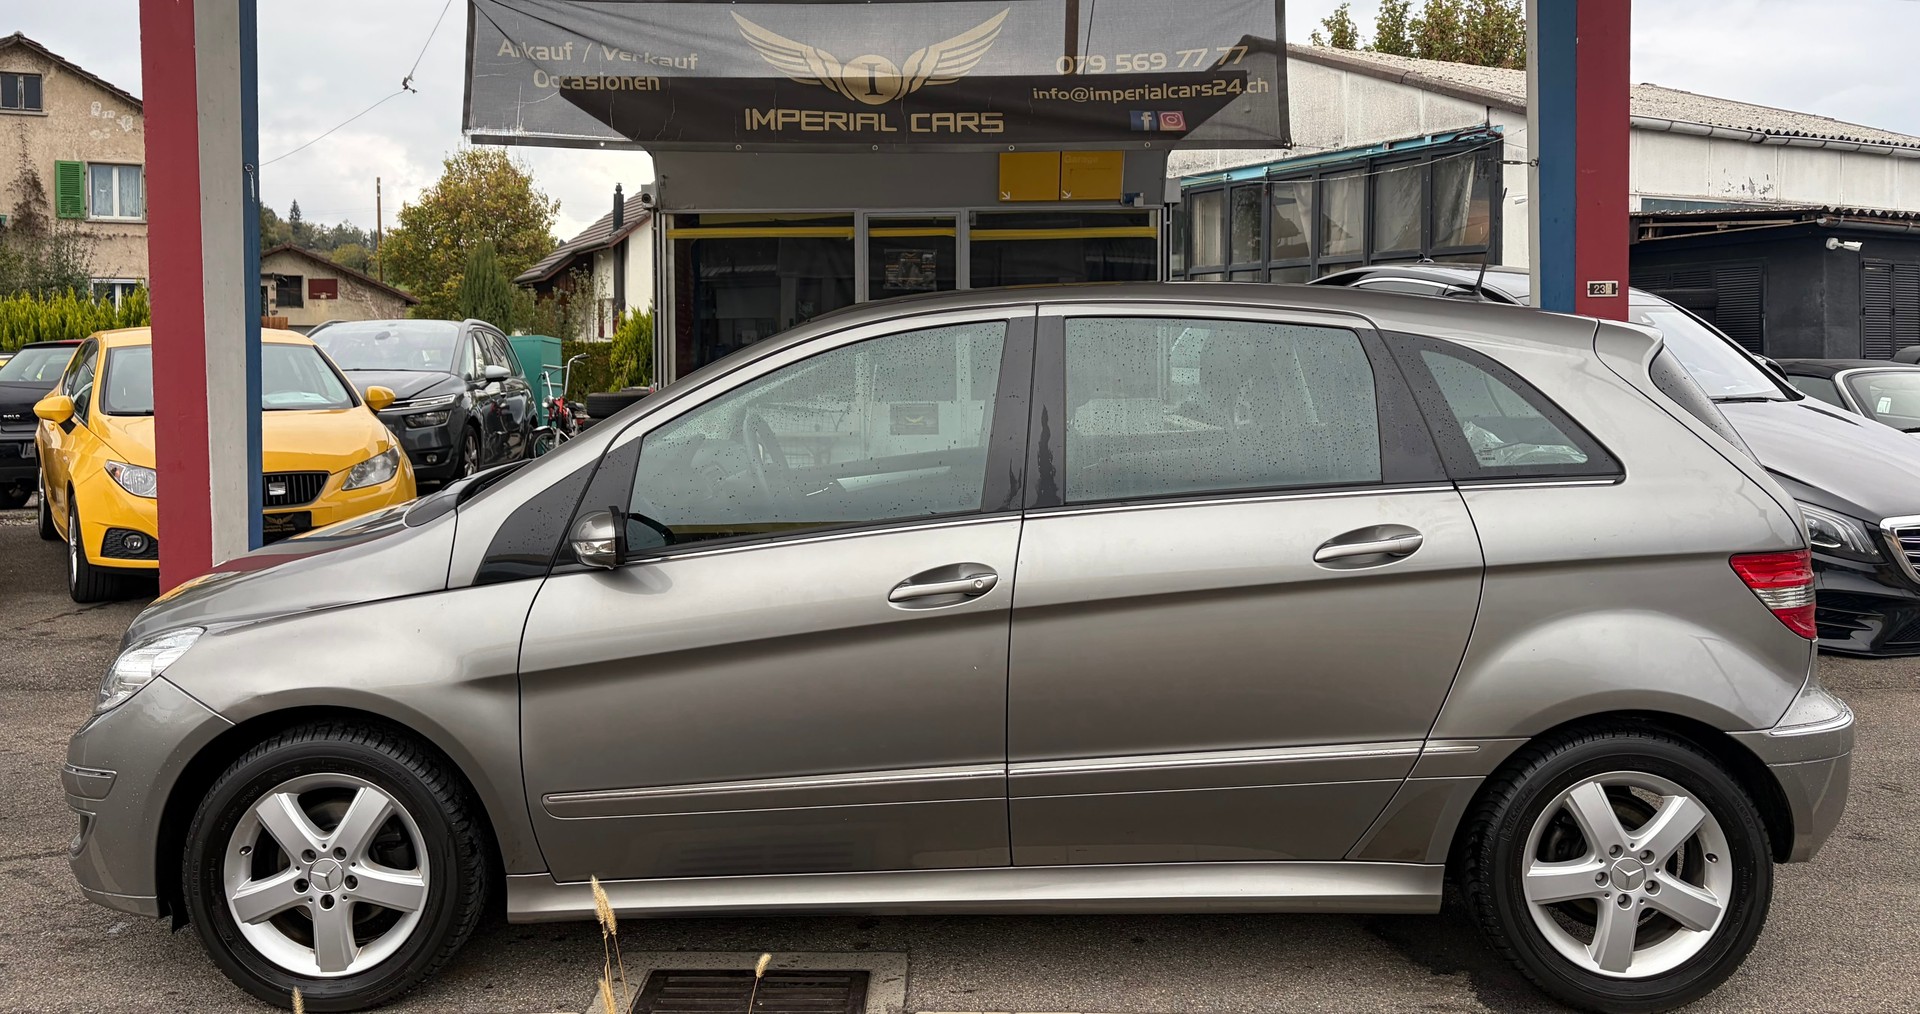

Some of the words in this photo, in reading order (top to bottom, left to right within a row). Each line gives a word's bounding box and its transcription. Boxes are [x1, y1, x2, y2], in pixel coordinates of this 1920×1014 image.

[601, 45, 699, 70] Verkauf
[1055, 54, 1107, 75] 079
[1115, 52, 1168, 73] 569
[1175, 48, 1208, 68] 77
[1217, 45, 1249, 66] 77
[533, 69, 660, 91] Occasionen
[1032, 77, 1270, 104] info@imperialcars24.ch
[744, 107, 898, 132] IMPERIAL
[910, 111, 1005, 133] CARS
[1593, 284, 1606, 294] 23
